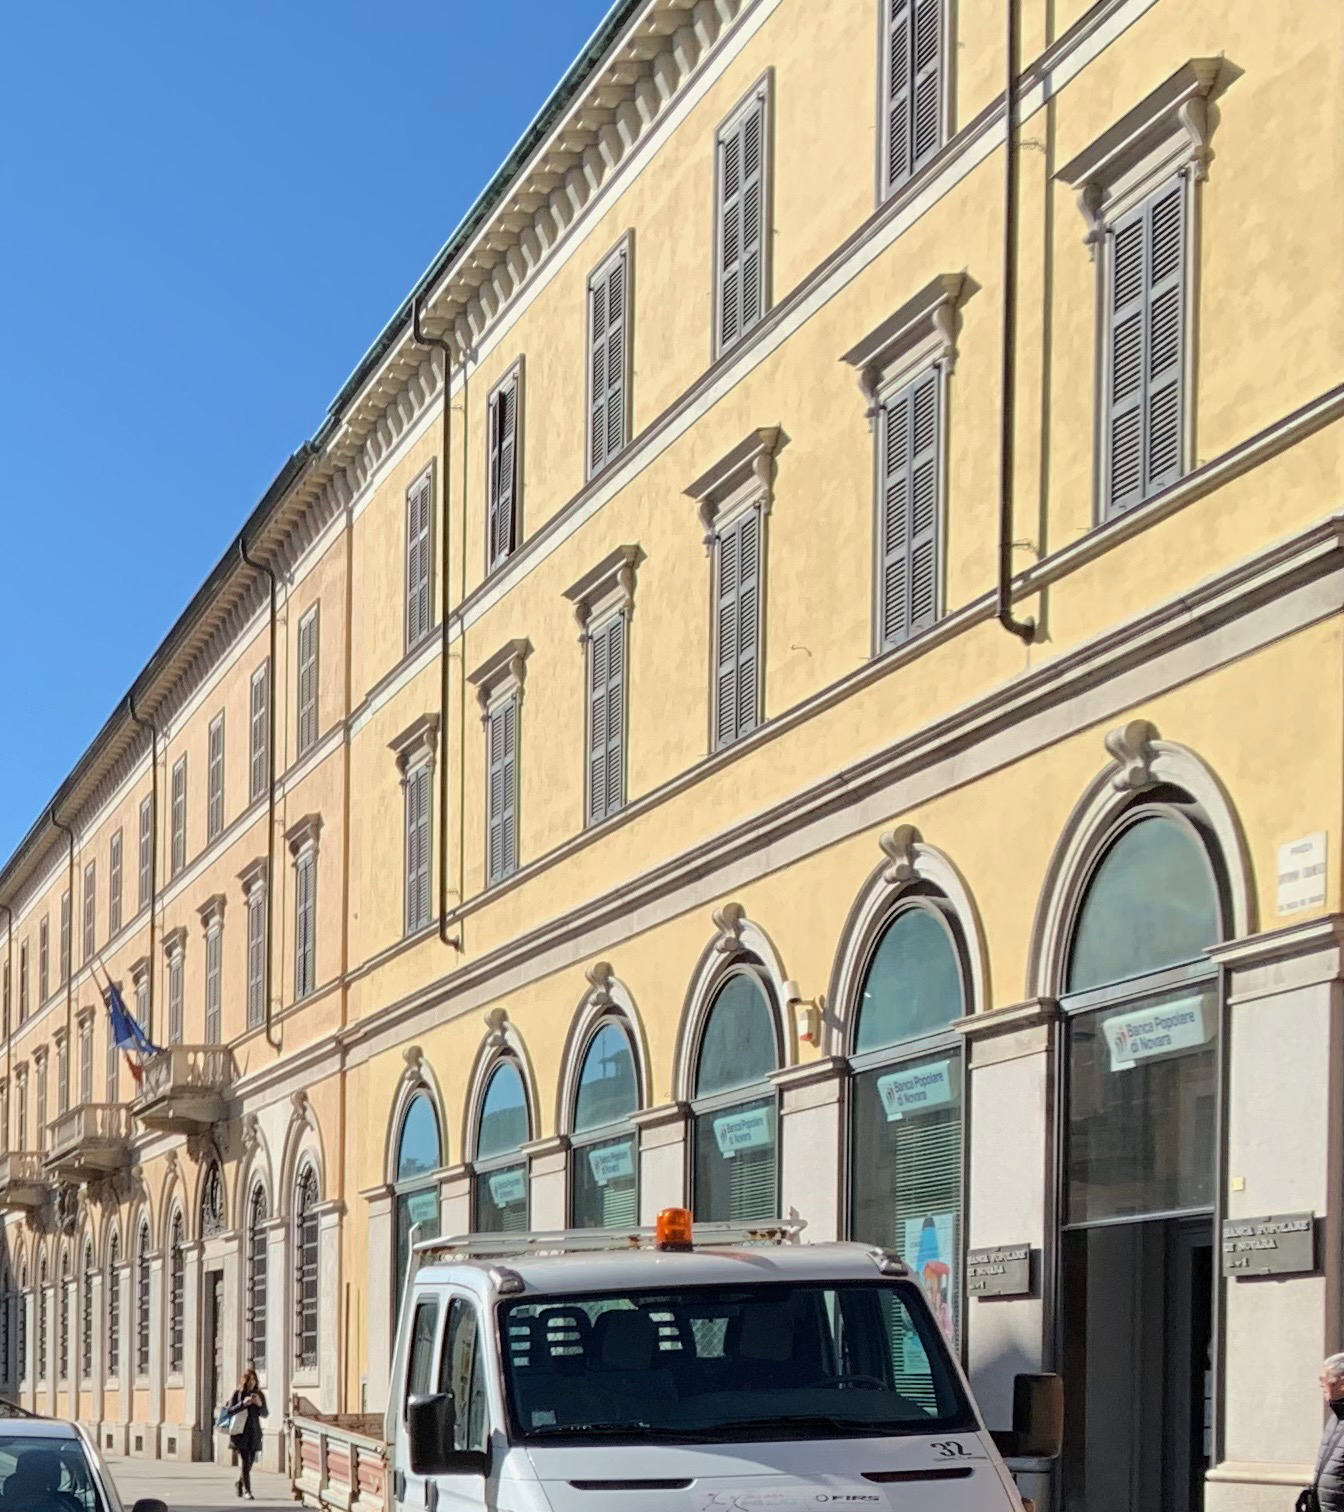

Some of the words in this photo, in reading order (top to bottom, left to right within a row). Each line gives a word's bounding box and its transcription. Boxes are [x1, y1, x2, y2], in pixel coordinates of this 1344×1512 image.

[1127, 1022, 1154, 1038] Banca
[1154, 1011, 1195, 1031] Popolare
[1140, 1034, 1171, 1050] Novara
[894, 1080, 914, 1093] Banca
[914, 1072, 944, 1088] Popolare
[904, 1090, 927, 1103] Novara
[930, 1441, 972, 1457] 32
